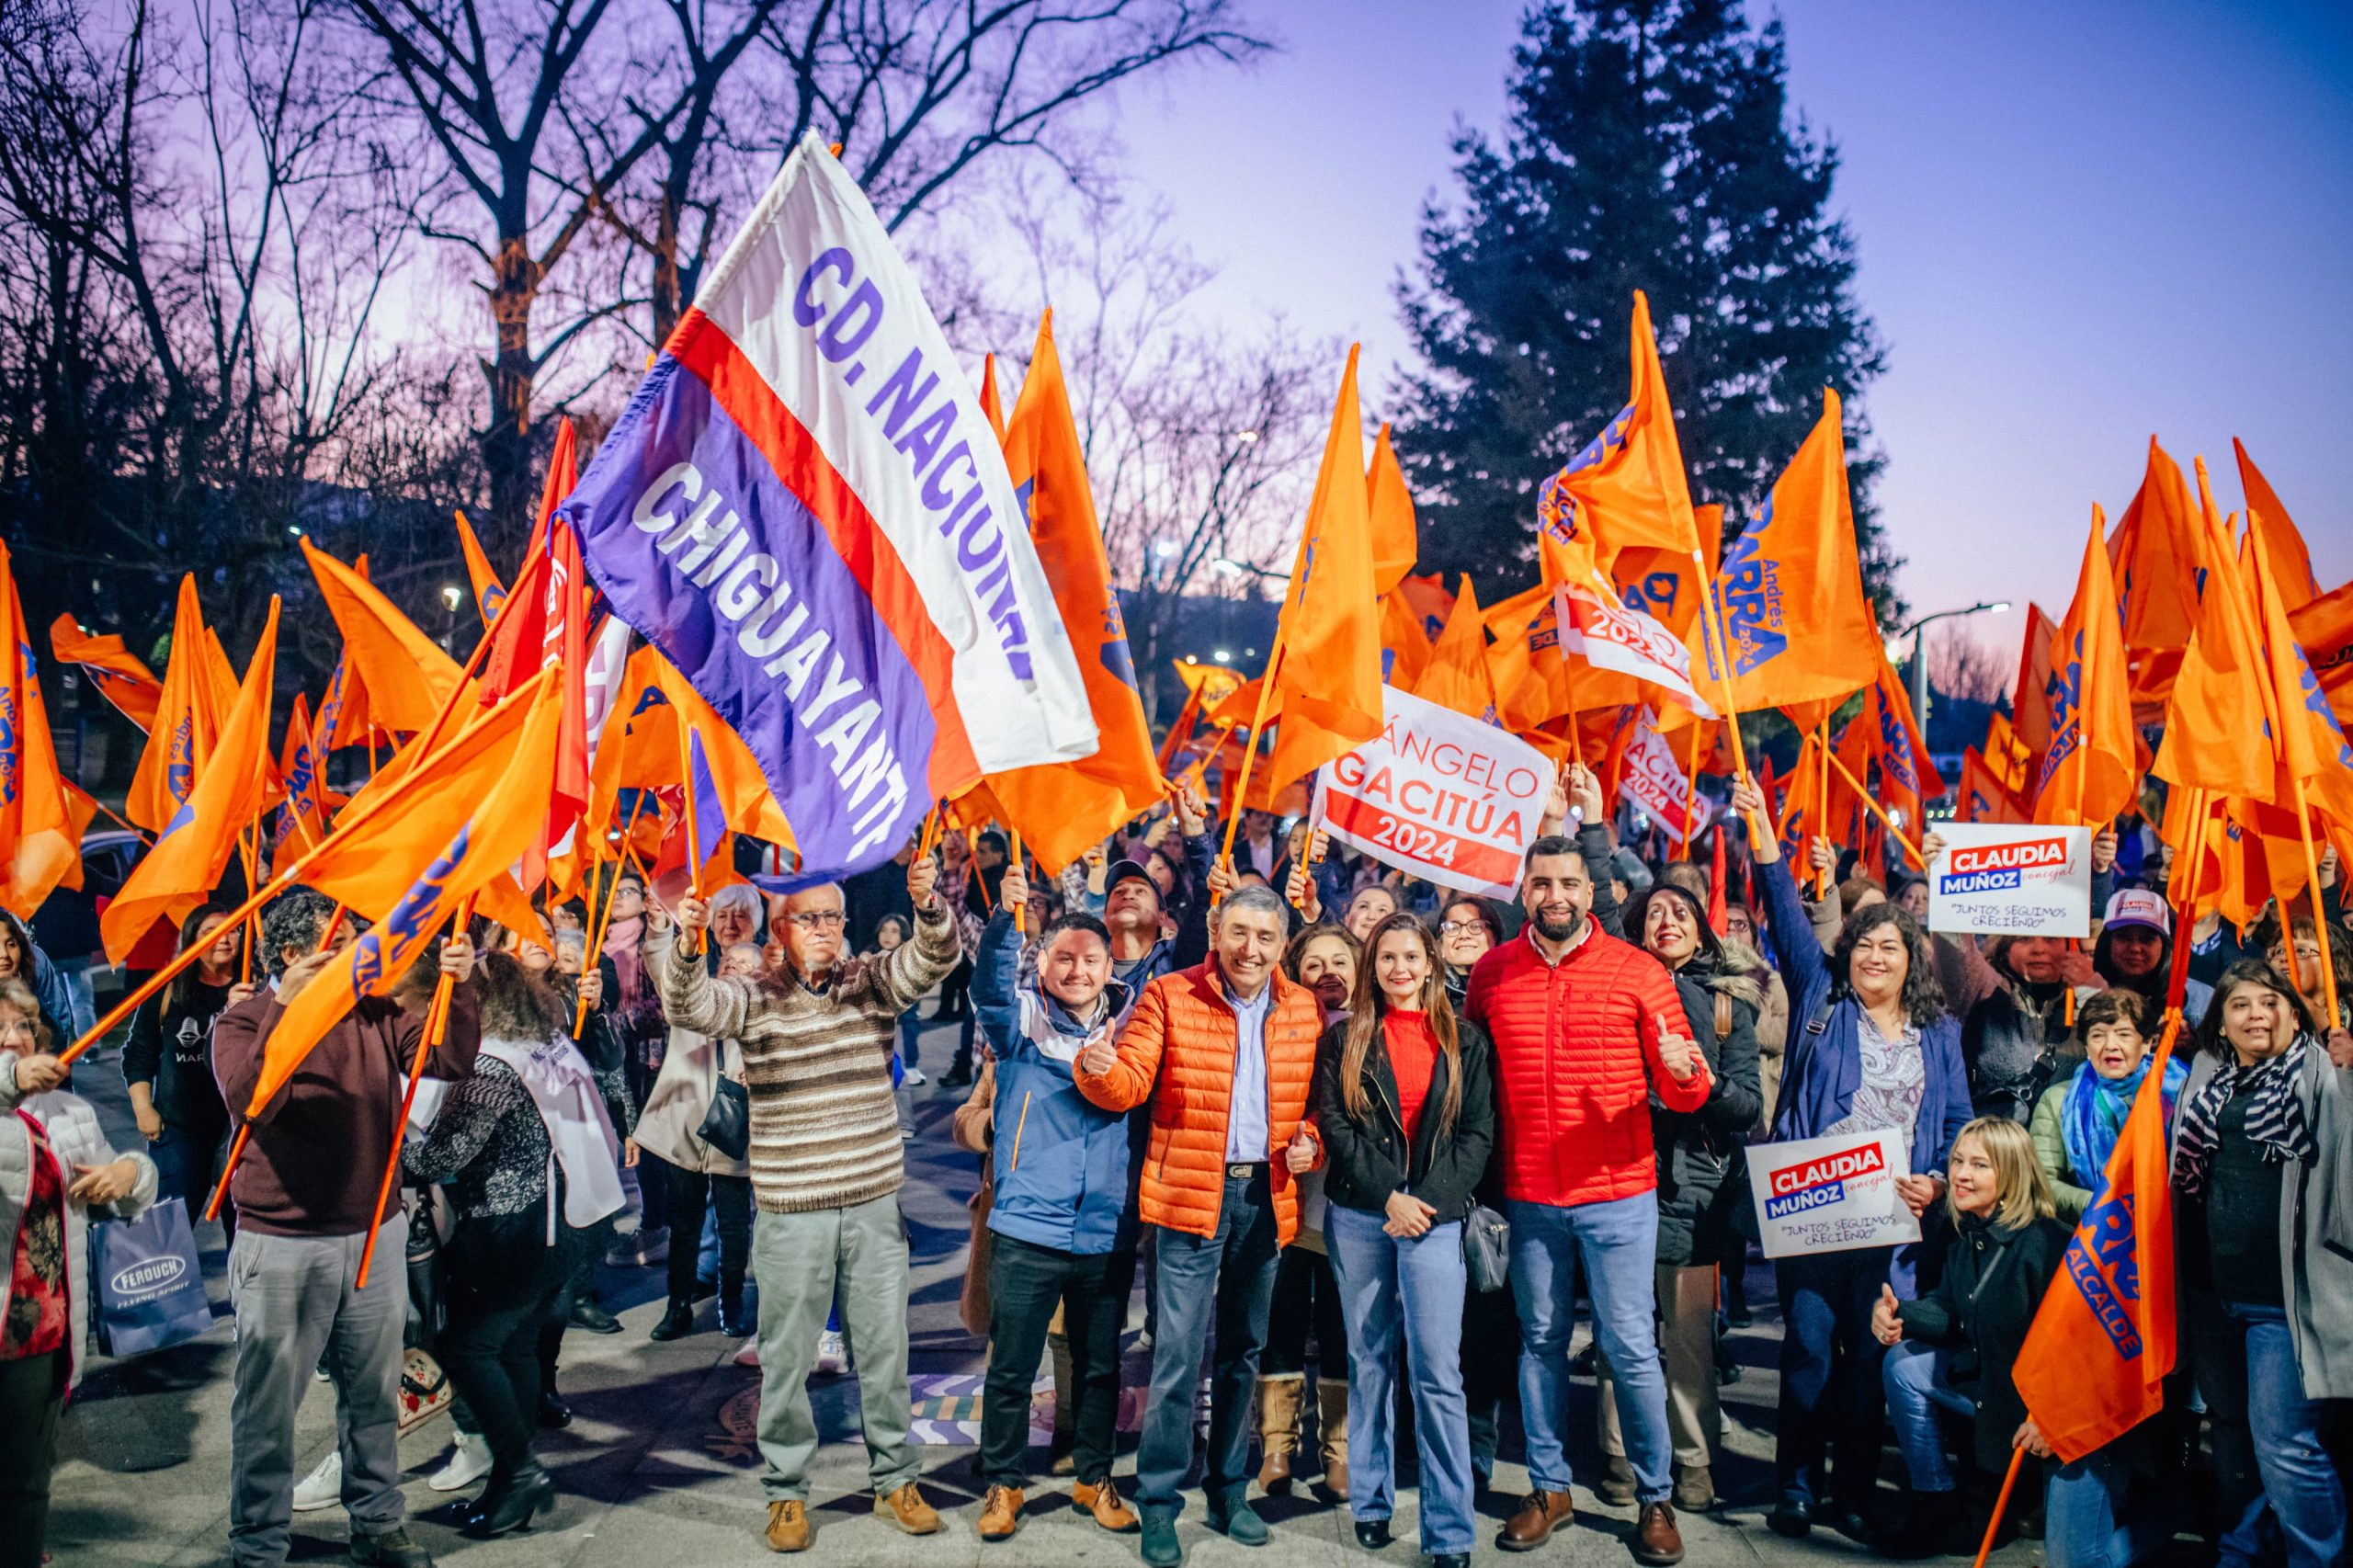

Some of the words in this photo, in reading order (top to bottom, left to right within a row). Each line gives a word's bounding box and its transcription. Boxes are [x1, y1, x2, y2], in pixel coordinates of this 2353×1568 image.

[793, 247, 884, 387] CD.
[1763, 559, 1787, 628] Andrés
[1373, 714, 1539, 798] ÁNGELO
[1334, 751, 1523, 846] GACITÚA
[1625, 769, 1669, 811] 2024
[1373, 816, 1458, 866] 2024
[1954, 842, 2063, 872] CLAUDIA
[1944, 871, 2018, 894] MUÑOZ
[2022, 858, 2076, 884] concejal
[1769, 1186, 1841, 1218] MUÑOZ
[1845, 1162, 1894, 1192] concejal
[1776, 1149, 1882, 1193] CLAUDIA
[2067, 1248, 2141, 1354] ALCALDE
